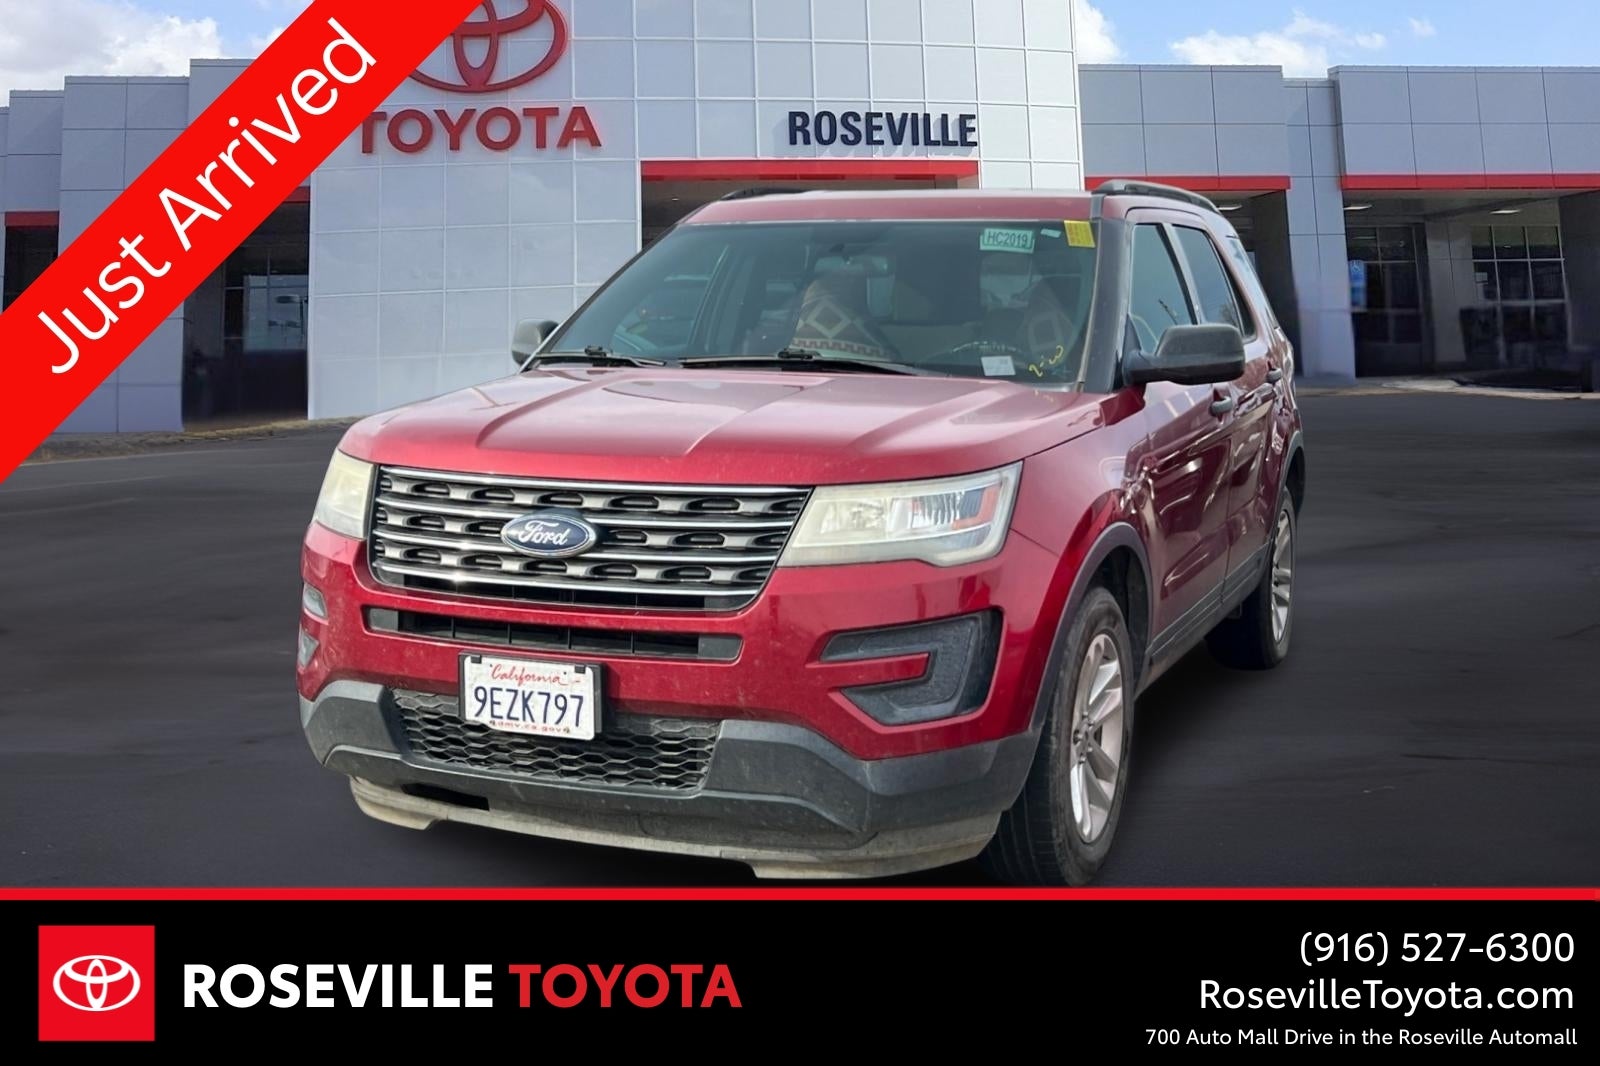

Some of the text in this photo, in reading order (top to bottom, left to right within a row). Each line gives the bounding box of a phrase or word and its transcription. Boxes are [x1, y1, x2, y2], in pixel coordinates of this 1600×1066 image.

[360, 106, 602, 154] TOYOTA
[788, 110, 978, 148] ROSEVILLE
[986, 231, 1029, 249] HC2019
[518, 520, 571, 546] Ford
[491, 663, 569, 687] California
[474, 686, 584, 728] 9EZK797
